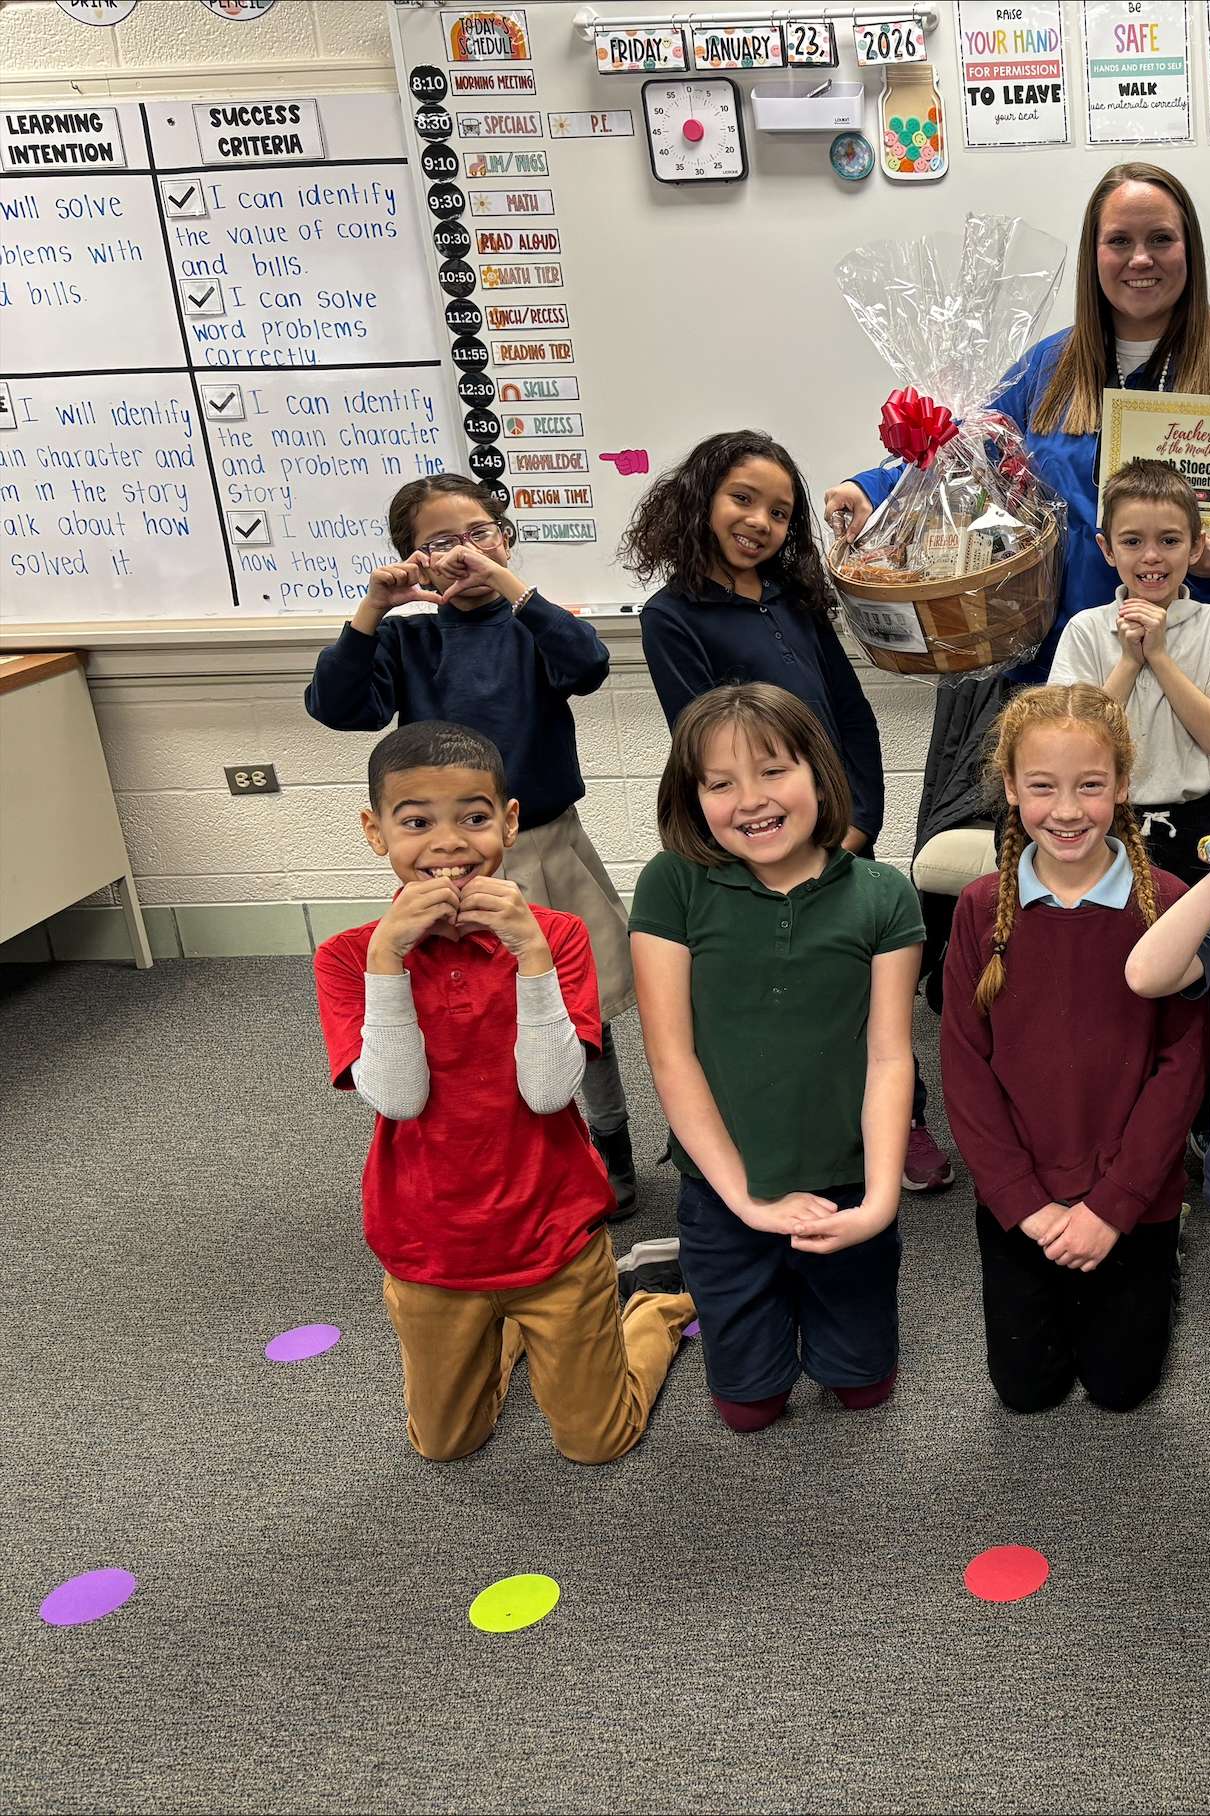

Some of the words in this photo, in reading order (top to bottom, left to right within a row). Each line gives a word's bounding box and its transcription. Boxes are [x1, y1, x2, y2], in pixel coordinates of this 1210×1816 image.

[459, 37, 515, 55] SCHEDULE
[795, 27, 825, 58] 23,
[864, 28, 916, 60] 2026
[965, 30, 1007, 55] YOUR
[1015, 28, 1058, 52] HAND
[1114, 24, 1159, 52] SAFE
[611, 39, 668, 63] FRIDAY,
[702, 36, 770, 61] JANUARY
[969, 66, 990, 78] FOR
[993, 63, 1057, 76] PERMISSION
[1093, 63, 1119, 73] HANDS
[1122, 63, 1137, 72] AND
[1140, 63, 1155, 71] FEET
[1156, 63, 1164, 71] TO
[1166, 62, 1183, 71] SELF
[412, 76, 444, 90] 8:10
[455, 76, 494, 90] MORNING
[498, 75, 533, 89] MEETING
[1119, 82, 1157, 96] WALK
[967, 87, 995, 106] TO
[1003, 84, 1061, 104] LEAVE
[1090, 101, 1105, 110] use
[1108, 99, 1148, 110] materials
[1150, 97, 1187, 110] correctly
[7, 113, 103, 135] LEARNING
[209, 104, 300, 128] SUCCESS
[485, 115, 537, 134] SPECIALS
[995, 111, 1016, 124] your
[1019, 109, 1039, 121] seat
[9, 142, 113, 166] INTENTION
[218, 133, 302, 157] CRITERIA
[424, 157, 457, 171] 9:10
[56, 194, 123, 219] solve
[239, 185, 283, 209] can
[299, 181, 395, 215] identify
[430, 195, 462, 209] 9:30
[506, 194, 539, 212] MATH
[176, 227, 210, 247] the
[227, 225, 288, 245] value
[299, 219, 322, 241] of
[337, 221, 397, 239] coins
[435, 234, 469, 244] 10:30
[519, 233, 556, 250] ALOUD
[182, 253, 227, 277] and
[440, 272, 474, 283] 10:50
[260, 291, 301, 308] can
[317, 290, 377, 309] solve
[447, 312, 481, 324] 11:20
[193, 320, 246, 342] word
[262, 319, 367, 344] problems
[453, 349, 487, 360] 11:55
[501, 344, 545, 361] READING
[549, 344, 571, 359] TIER
[459, 385, 494, 396] 12:30
[523, 381, 559, 398] SKILLS
[287, 394, 329, 414] can
[345, 389, 433, 422] identify
[218, 428, 253, 447] the
[272, 428, 326, 446] main
[340, 422, 440, 446] character
[467, 421, 498, 433] 1:30
[534, 417, 573, 434] RECESS
[37, 443, 143, 469] character
[156, 444, 195, 468] and
[472, 456, 502, 467] 1:45
[517, 453, 583, 471] KNOWLEDGE
[281, 454, 369, 481] problem
[58, 511, 125, 535] about
[143, 512, 190, 535] how
[542, 524, 593, 539] DISMISSAL
[11, 549, 88, 575] solved
